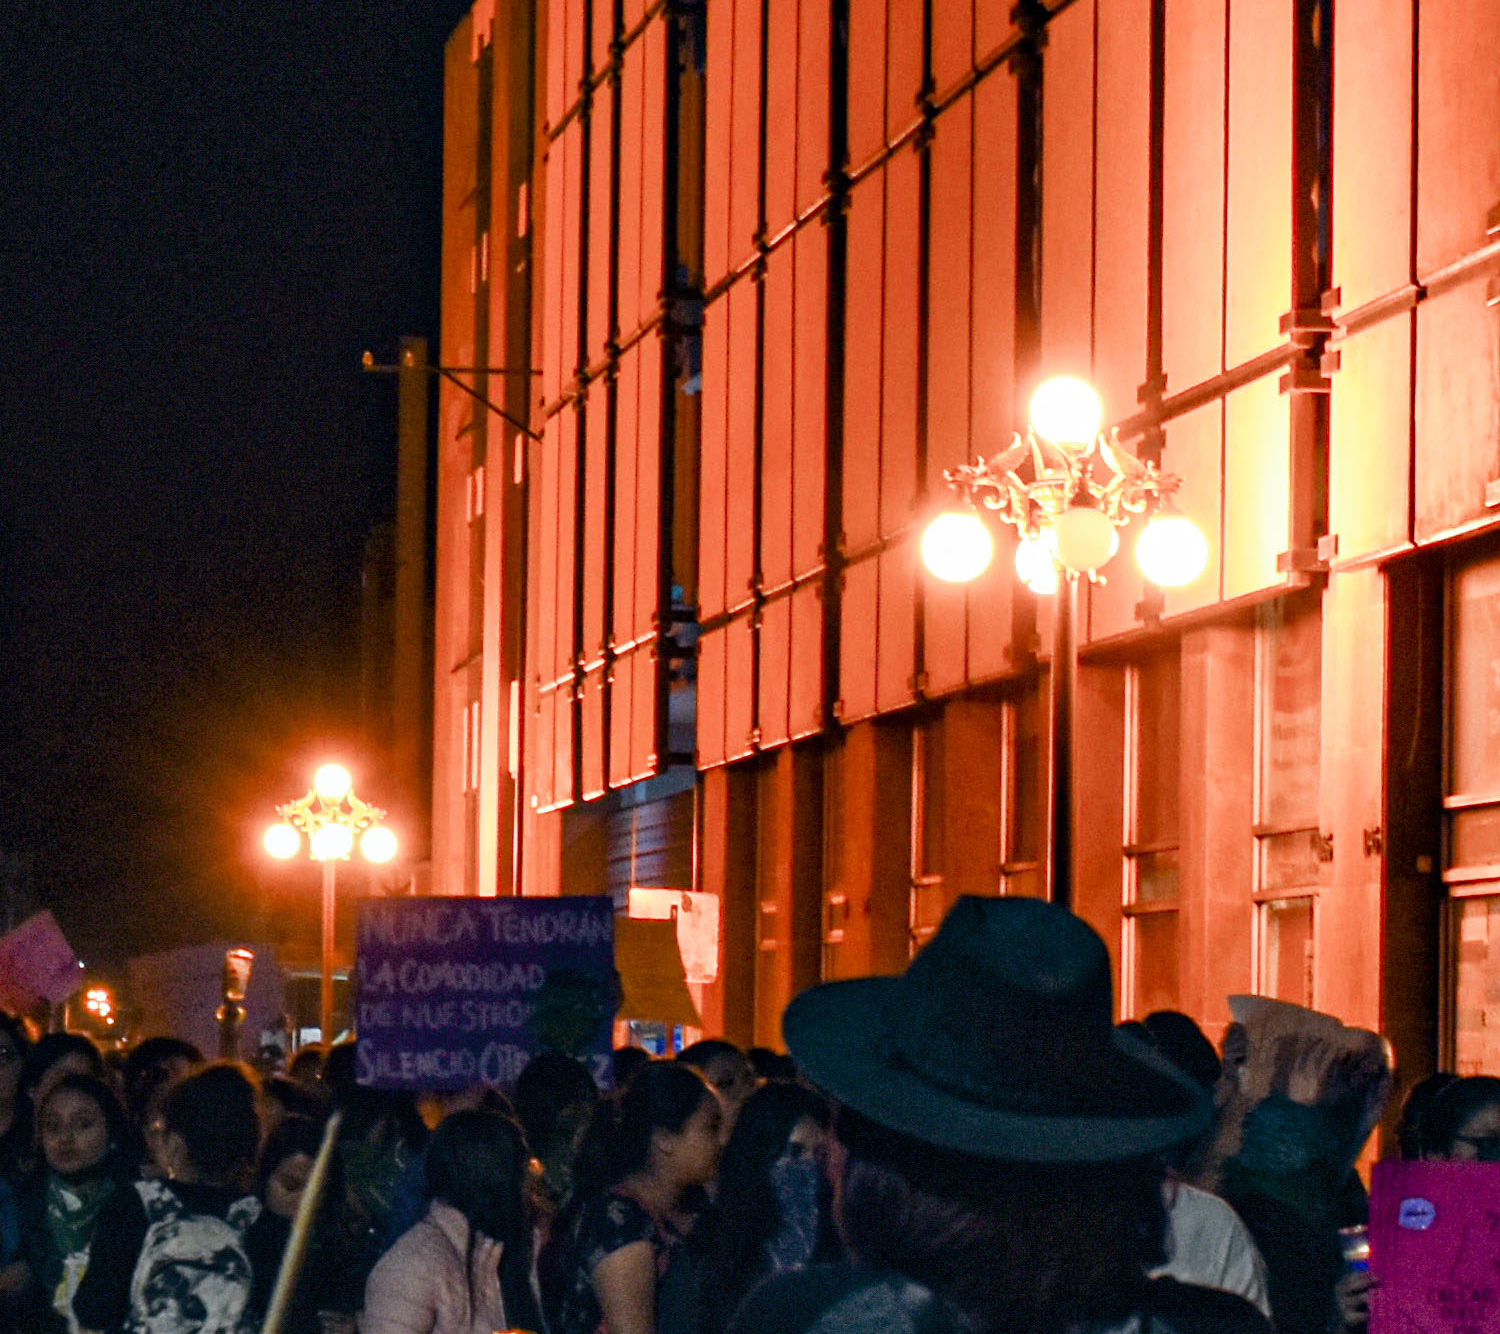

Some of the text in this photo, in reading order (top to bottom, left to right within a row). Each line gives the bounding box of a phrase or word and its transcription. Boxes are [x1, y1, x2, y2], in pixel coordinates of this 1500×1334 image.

[361, 904, 477, 945] NUNCA
[358, 957, 546, 995] LA COMODIDAD
[360, 1002, 394, 1028] DE
[355, 1038, 476, 1087] SILENCIO
